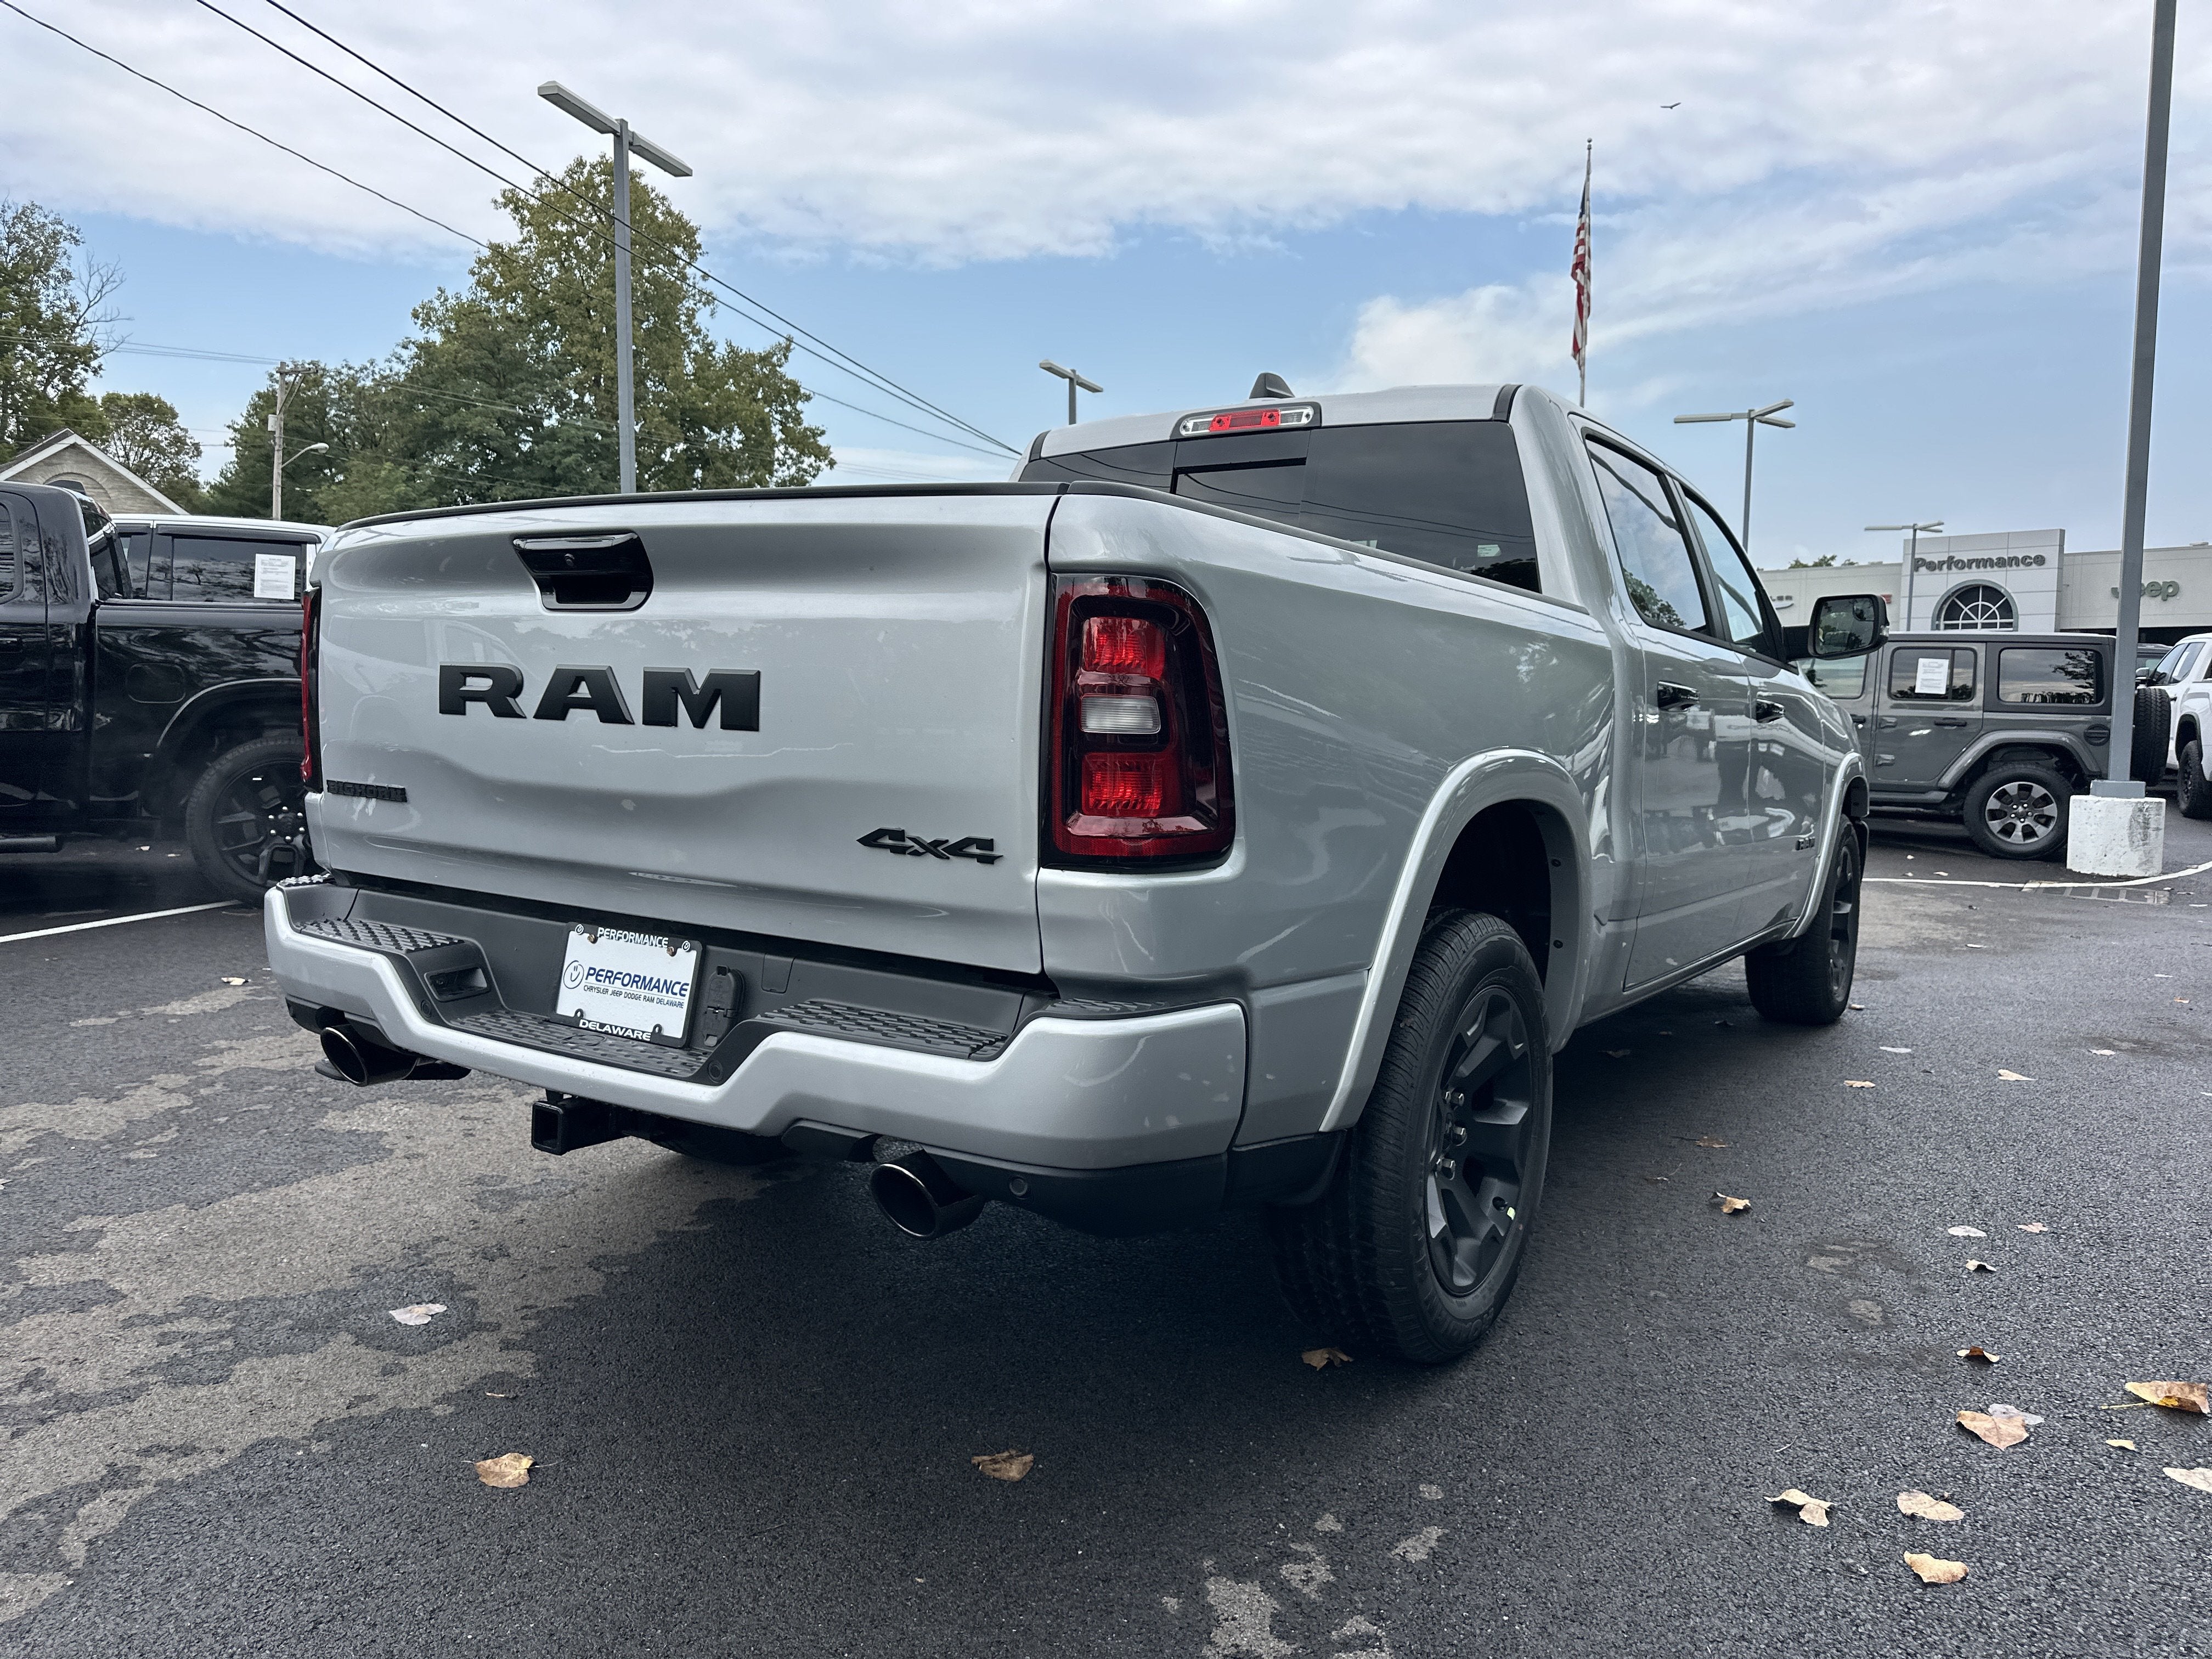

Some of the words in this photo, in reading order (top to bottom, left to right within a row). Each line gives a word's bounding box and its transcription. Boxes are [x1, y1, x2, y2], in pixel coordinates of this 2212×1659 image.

[1914, 554, 2046, 572] Performance
[2111, 580, 2180, 601] ep
[439, 662, 760, 732] RAM
[597, 927, 669, 949] PERFORMANCE
[585, 966, 690, 997] PERFORMANCE
[584, 985, 609, 995] CHRYSLER
[610, 989, 623, 997] JEEP
[624, 992, 642, 1001] DODGE
[642, 995, 655, 1003] RAM
[656, 997, 685, 1009] DELAWARE
[579, 1019, 652, 1041] DELAWARE
